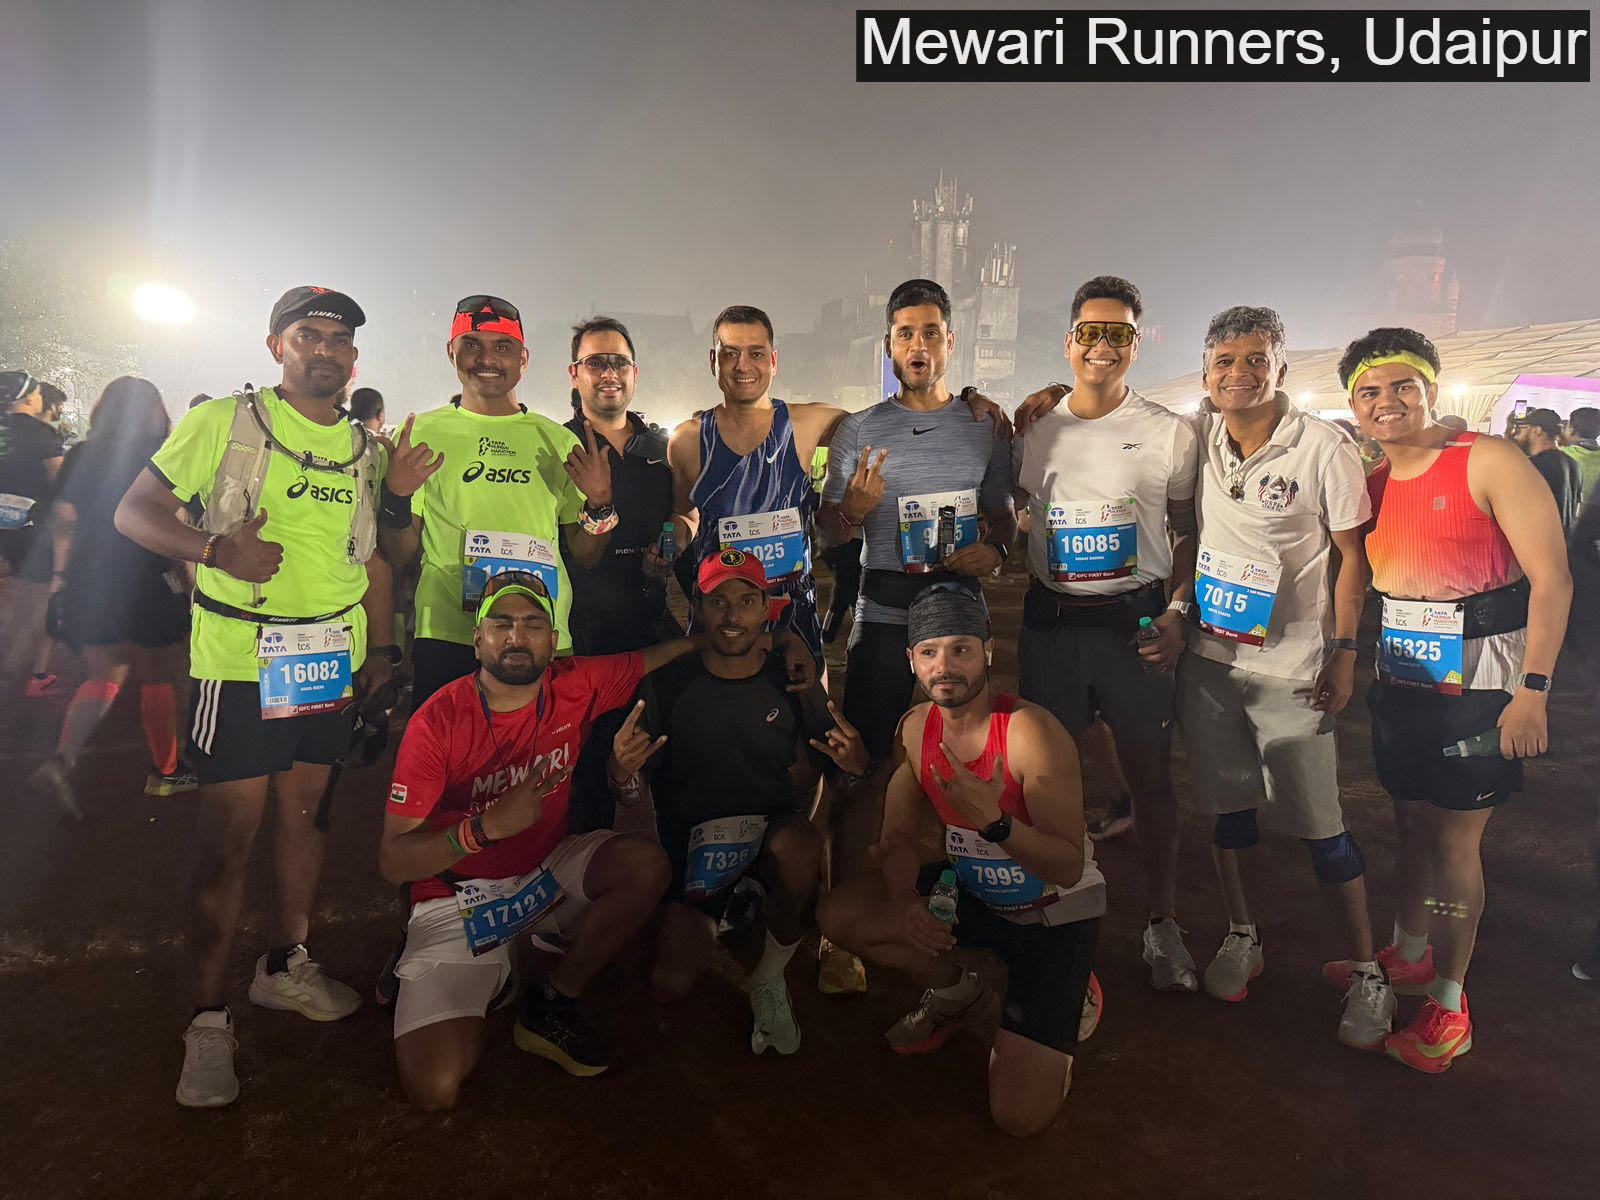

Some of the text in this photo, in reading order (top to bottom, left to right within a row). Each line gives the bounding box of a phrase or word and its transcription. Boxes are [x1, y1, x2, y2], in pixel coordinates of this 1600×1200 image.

[469, 546, 491, 554] TATA
[1061, 533, 1121, 554] 16085
[1203, 583, 1249, 613] 7015
[1385, 635, 1441, 662] 15325
[280, 660, 340, 685] 16082
[949, 844, 969, 854] TATA
[971, 865, 1026, 886] 7995
[464, 894, 487, 905] TATA
[482, 885, 548, 928] 17121
